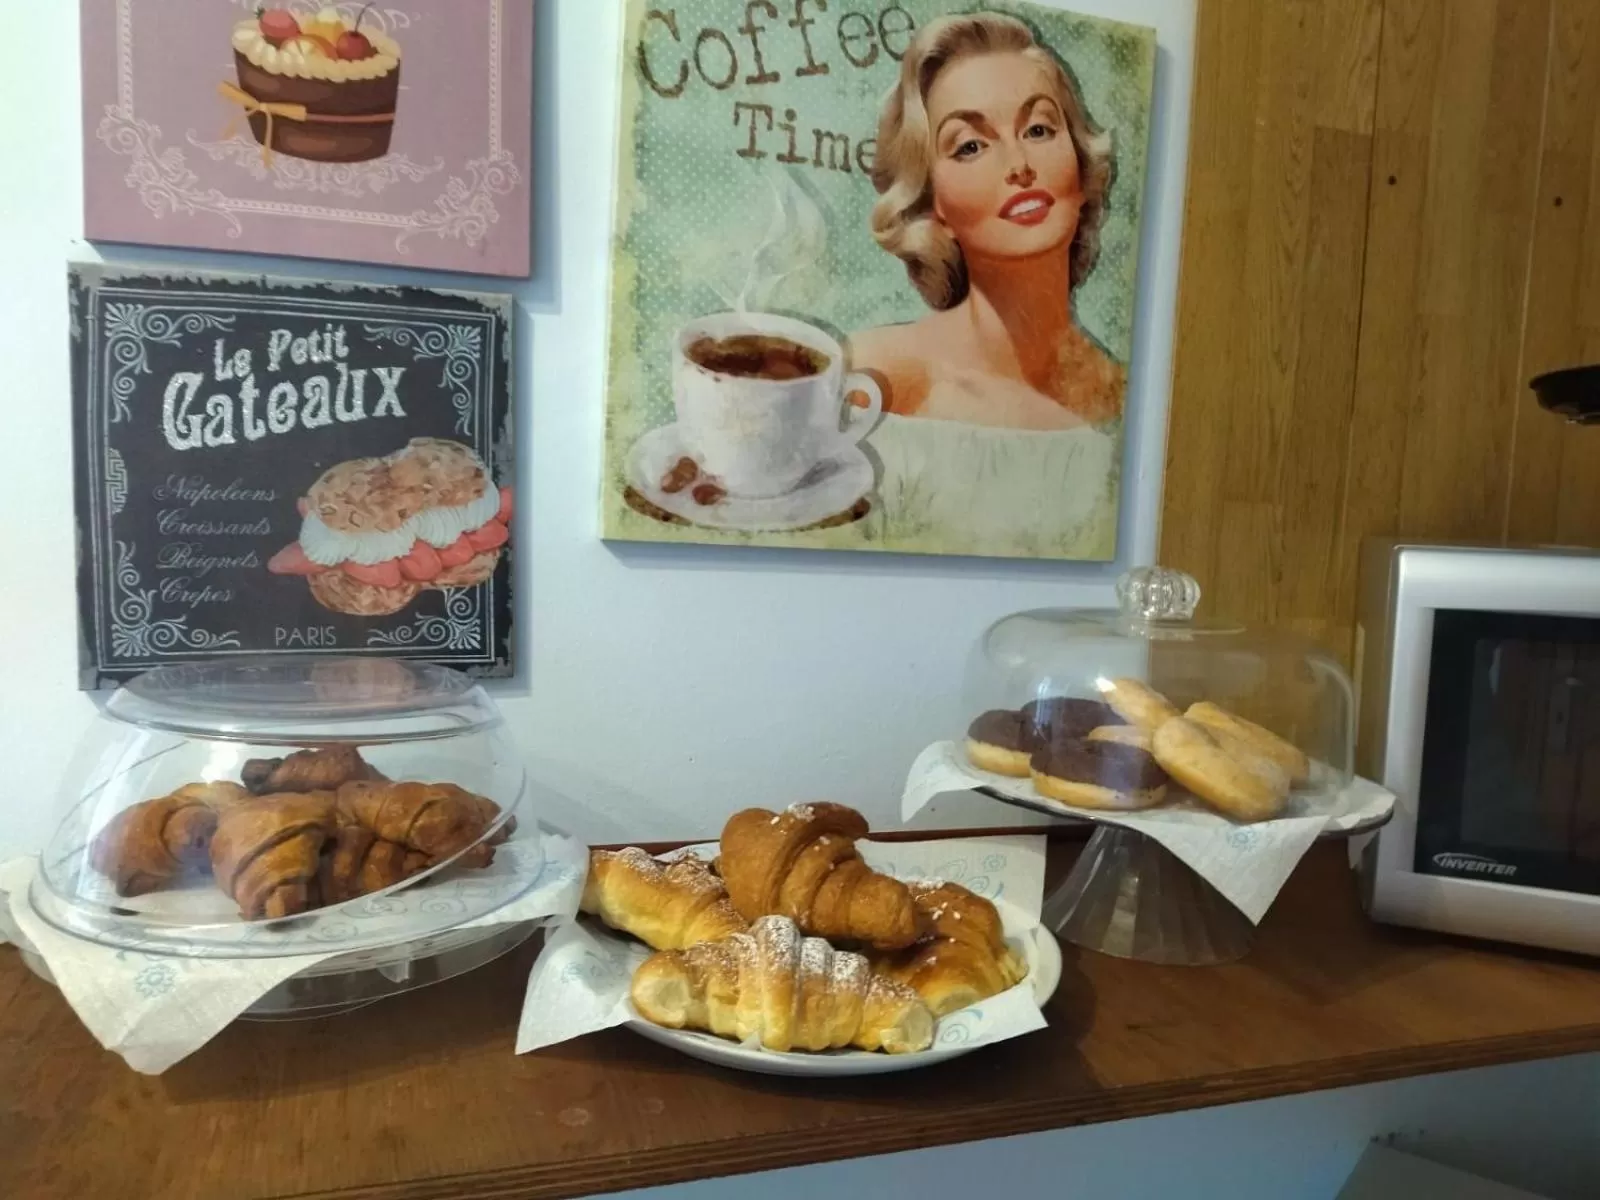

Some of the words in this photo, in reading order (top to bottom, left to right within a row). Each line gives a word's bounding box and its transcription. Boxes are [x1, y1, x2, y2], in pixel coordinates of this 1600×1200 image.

[636, 0, 916, 98] Coffee
[733, 101, 877, 174] Time
[214, 339, 252, 381] Le
[267, 323, 349, 371] Petit
[163, 362, 407, 450] Gateaux
[153, 474, 277, 507] Napoleons
[156, 508, 271, 535] Croissants
[275, 626, 337, 646] PARIS
[1440, 856, 1518, 876] INVERTER
